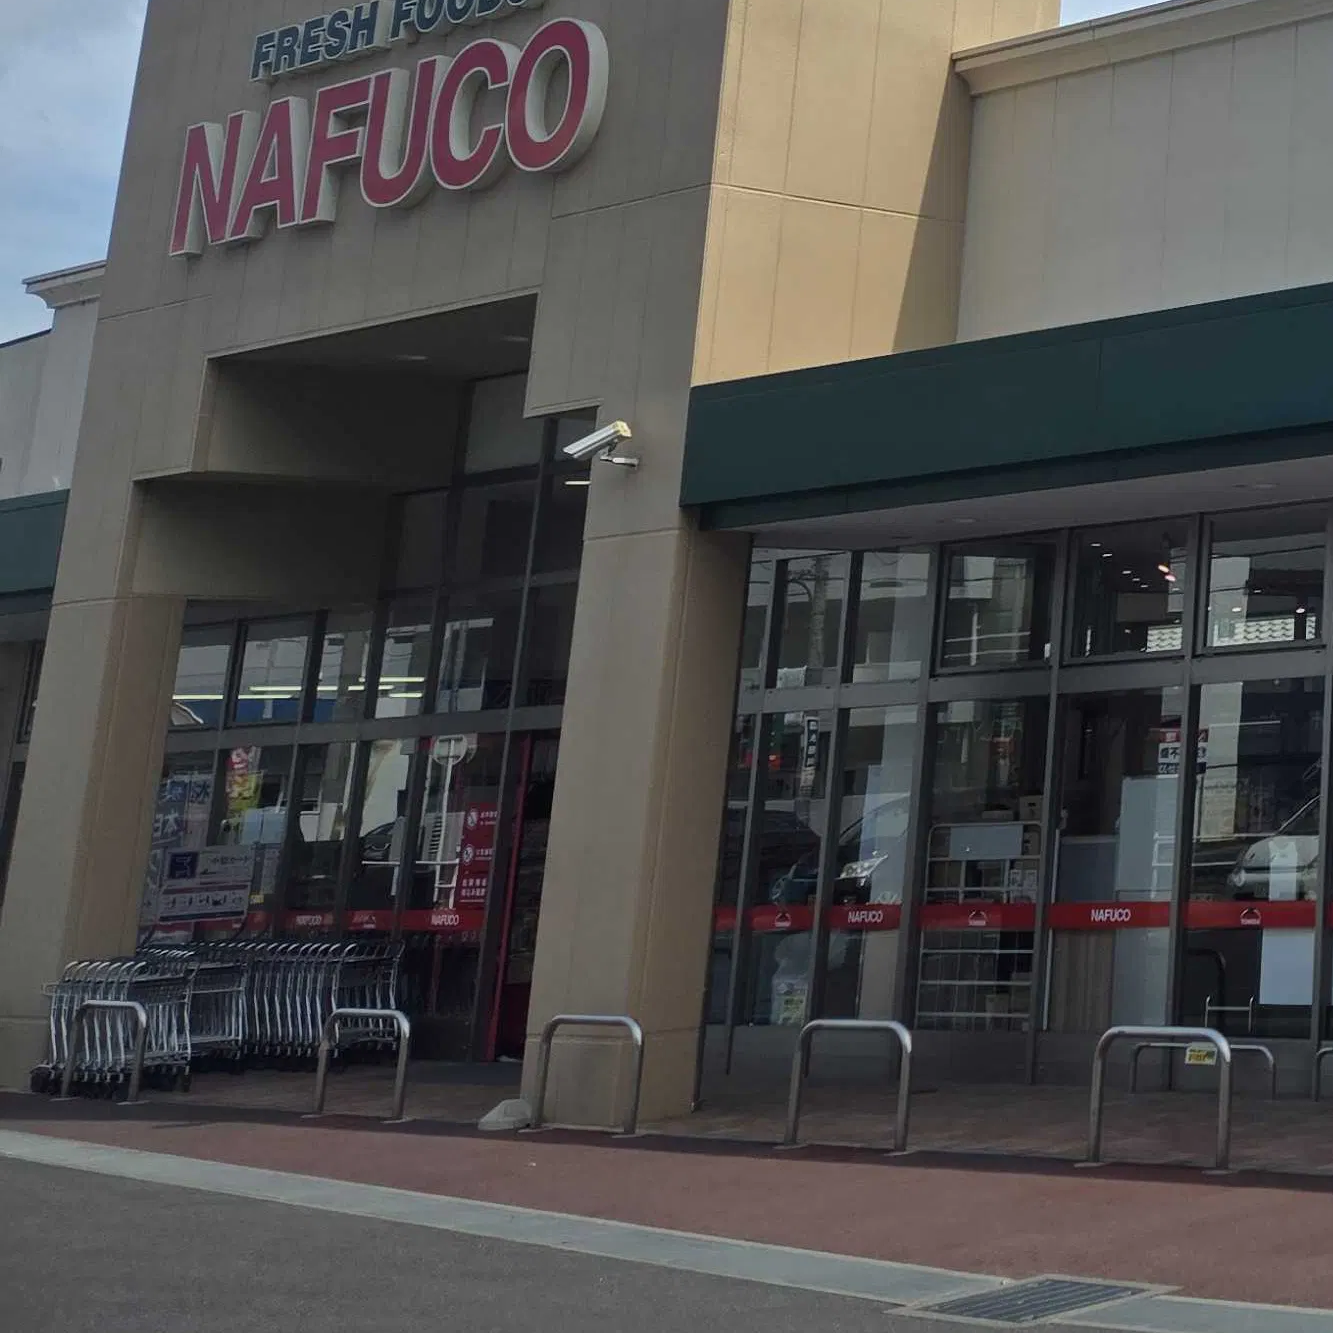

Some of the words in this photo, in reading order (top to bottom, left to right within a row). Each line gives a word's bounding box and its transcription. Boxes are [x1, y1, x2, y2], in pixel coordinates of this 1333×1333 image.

[249, 0, 390, 83] FRESH
[169, 17, 609, 257] NAFUCO
[848, 909, 883, 923] NAFUCO
[1091, 908, 1131, 922] NAFUCO
